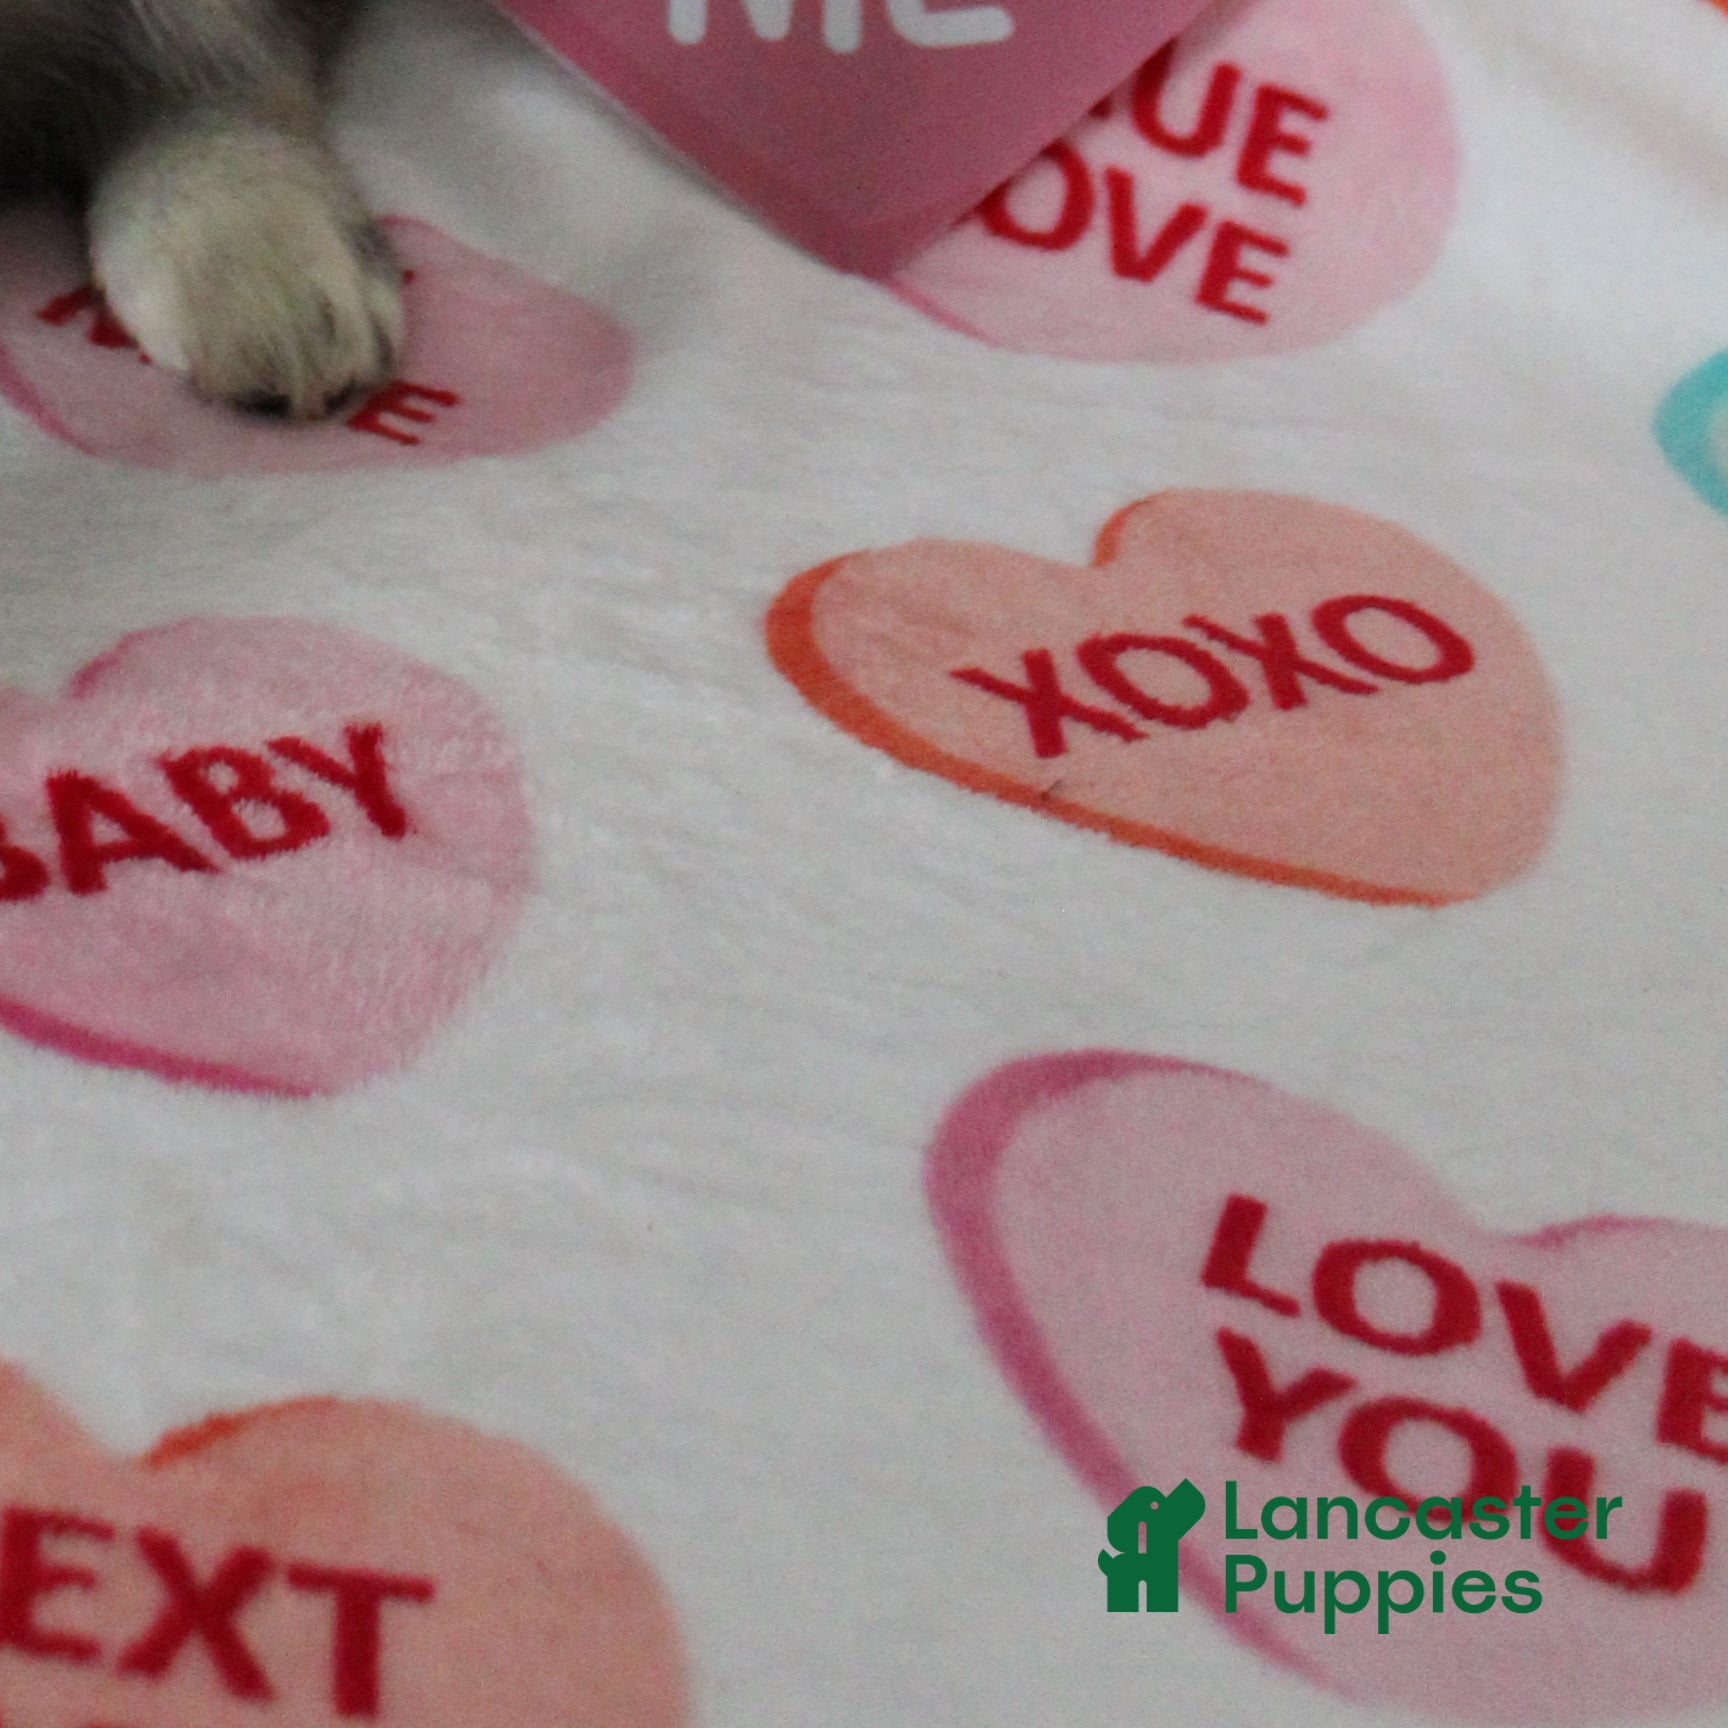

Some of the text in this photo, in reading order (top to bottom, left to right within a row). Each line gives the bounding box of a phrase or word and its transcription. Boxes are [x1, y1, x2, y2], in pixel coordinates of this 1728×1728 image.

[1087, 36, 1330, 209] UE
[944, 138, 1292, 326] OVE
[948, 593, 1475, 759] XOXO
[1200, 1192, 1728, 1466] LOVE
[1216, 1326, 1709, 1594] YOU
